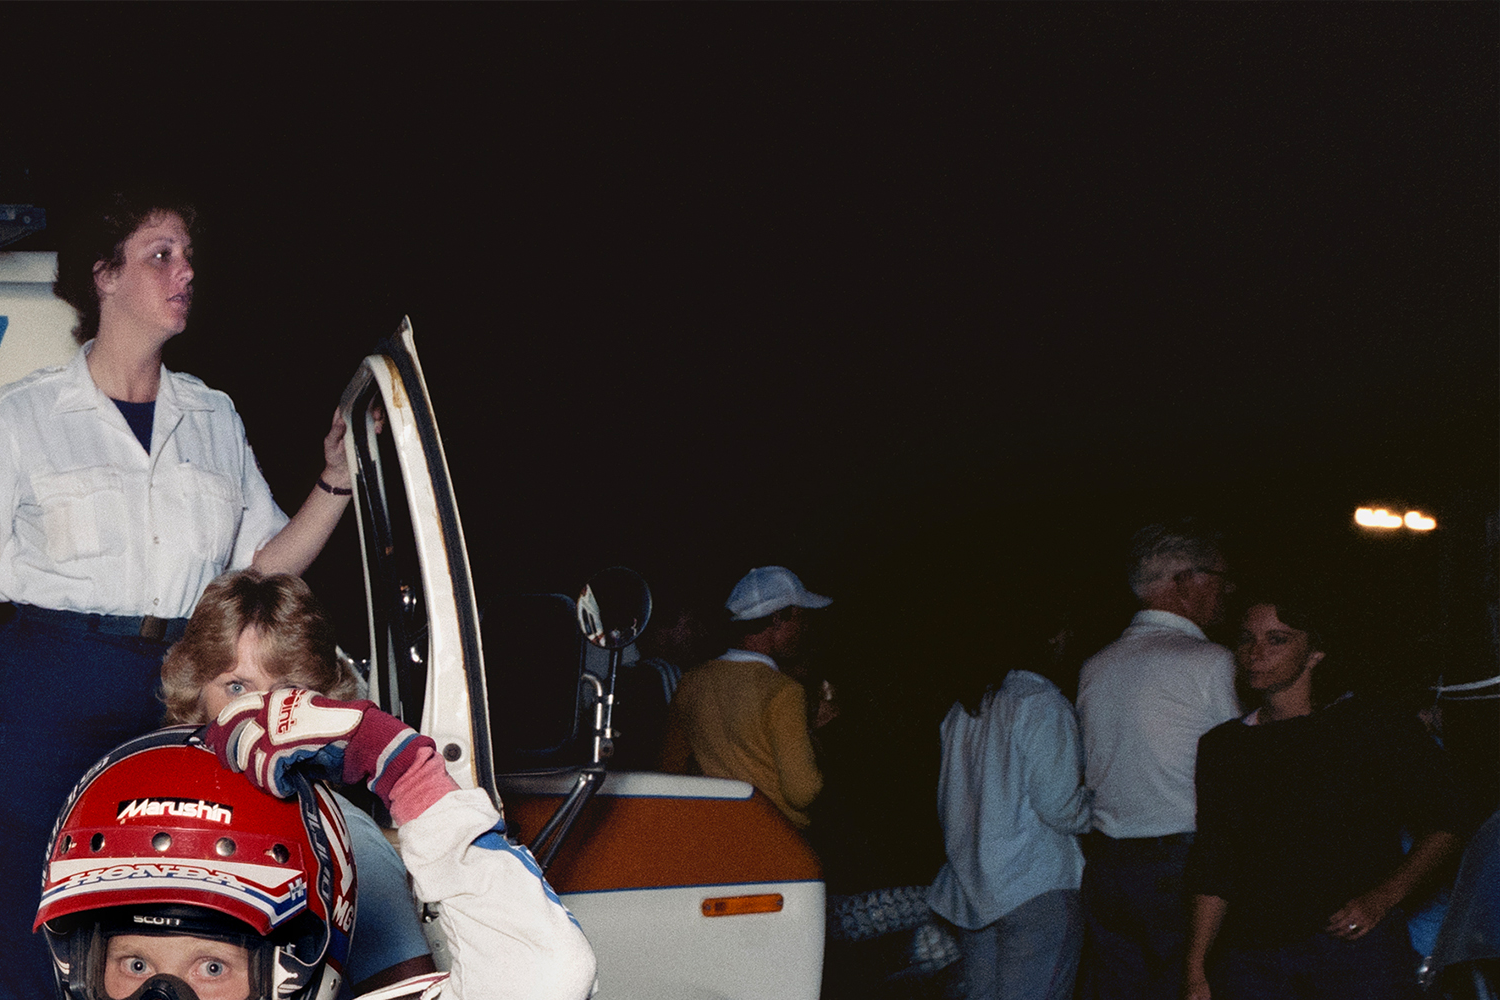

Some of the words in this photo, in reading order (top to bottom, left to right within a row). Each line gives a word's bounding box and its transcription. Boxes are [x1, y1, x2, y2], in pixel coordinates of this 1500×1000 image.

[116, 798, 233, 825] Marushin
[64, 863, 246, 891] HONDA
[133, 915, 182, 927] SCOTT
